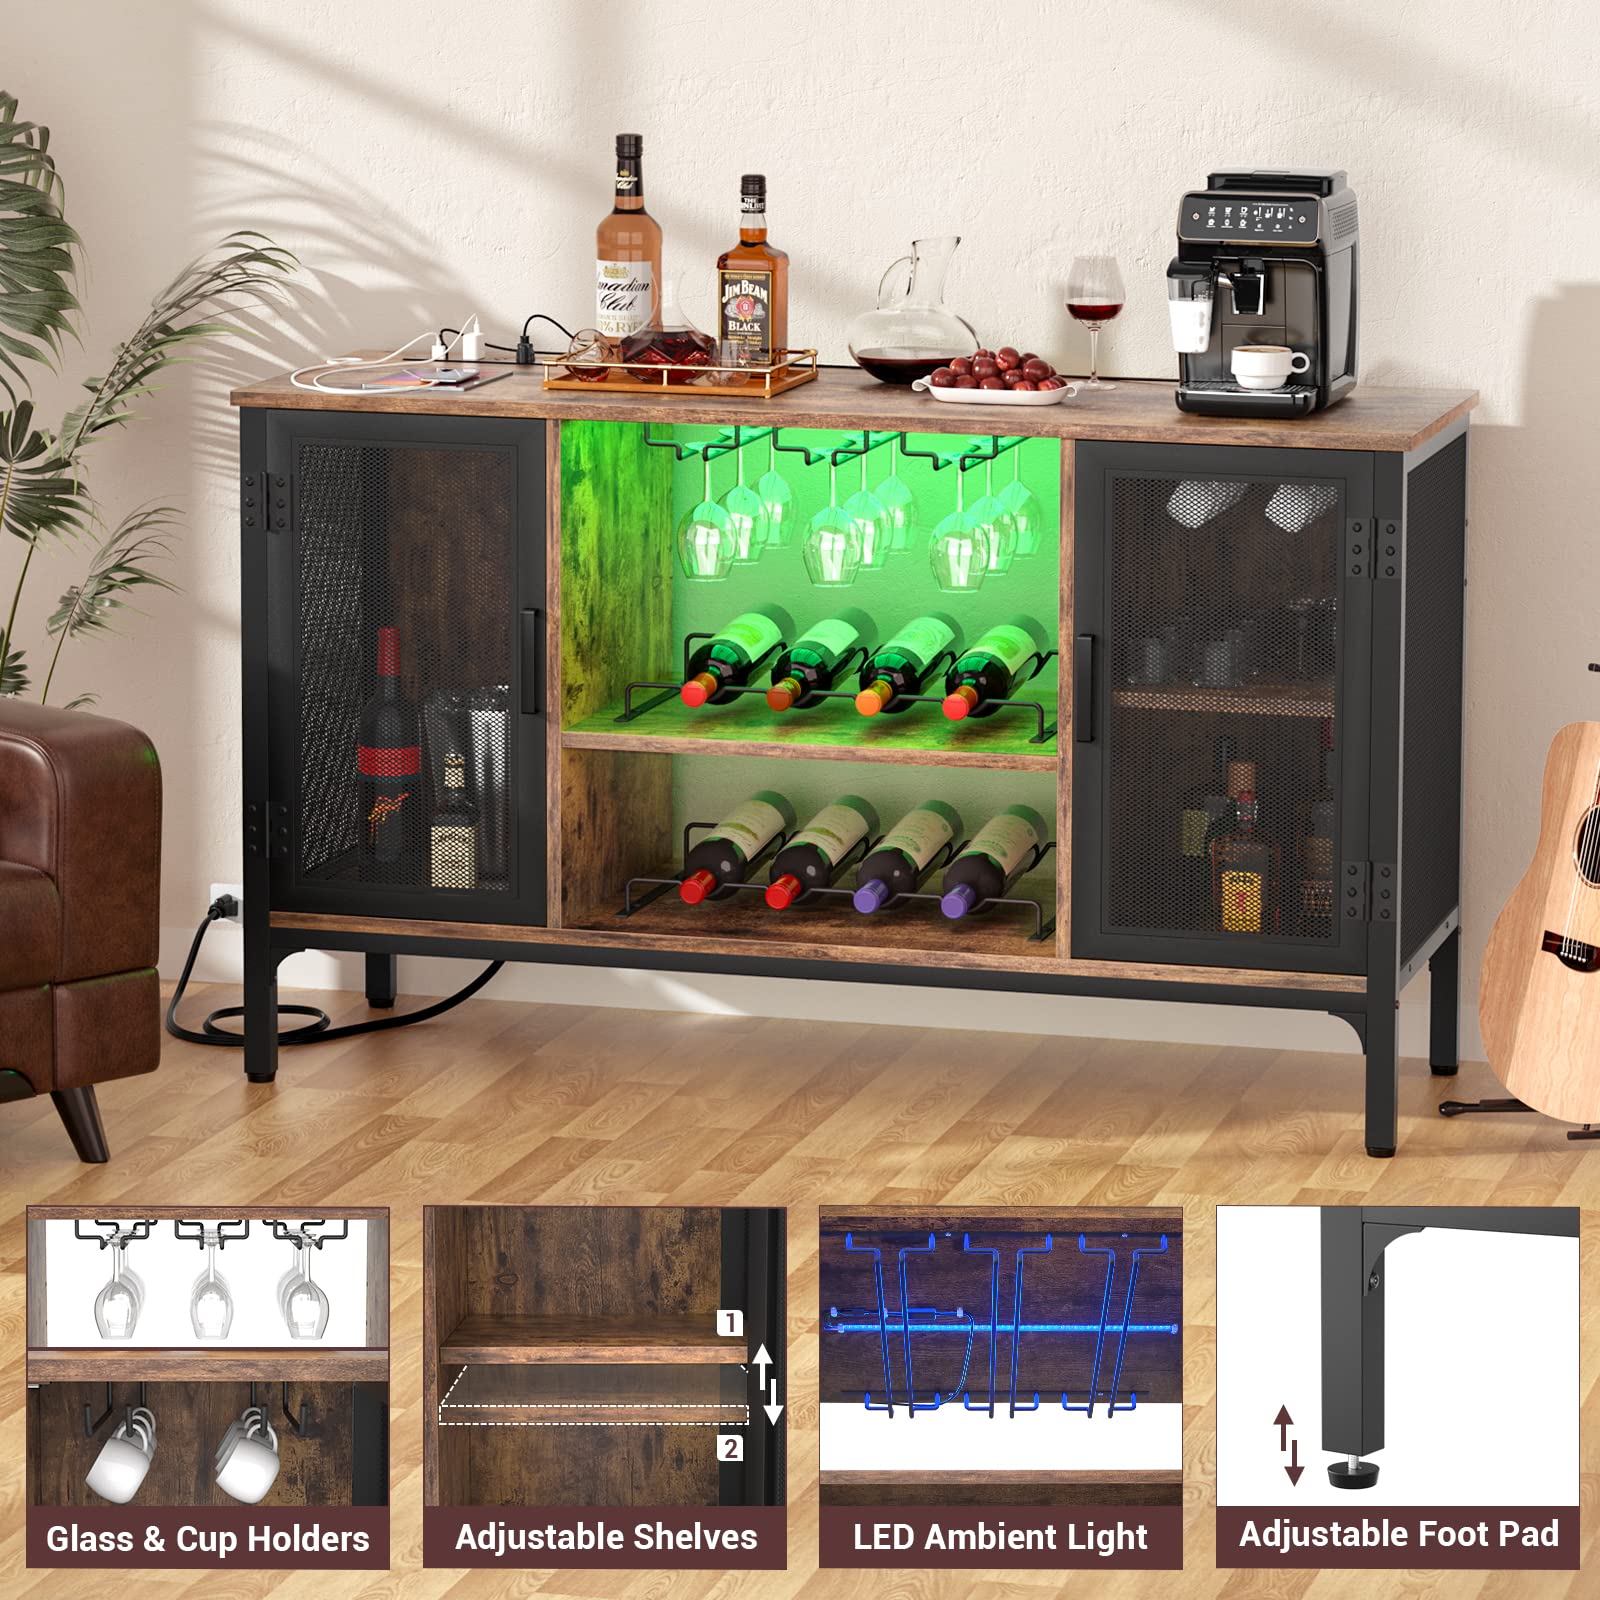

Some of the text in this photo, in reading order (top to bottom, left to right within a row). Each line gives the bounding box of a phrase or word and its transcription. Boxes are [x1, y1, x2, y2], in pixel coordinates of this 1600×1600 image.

[600, 291, 638, 311] Club
[722, 279, 768, 304] JIM BEAM
[728, 320, 761, 332] BLACK
